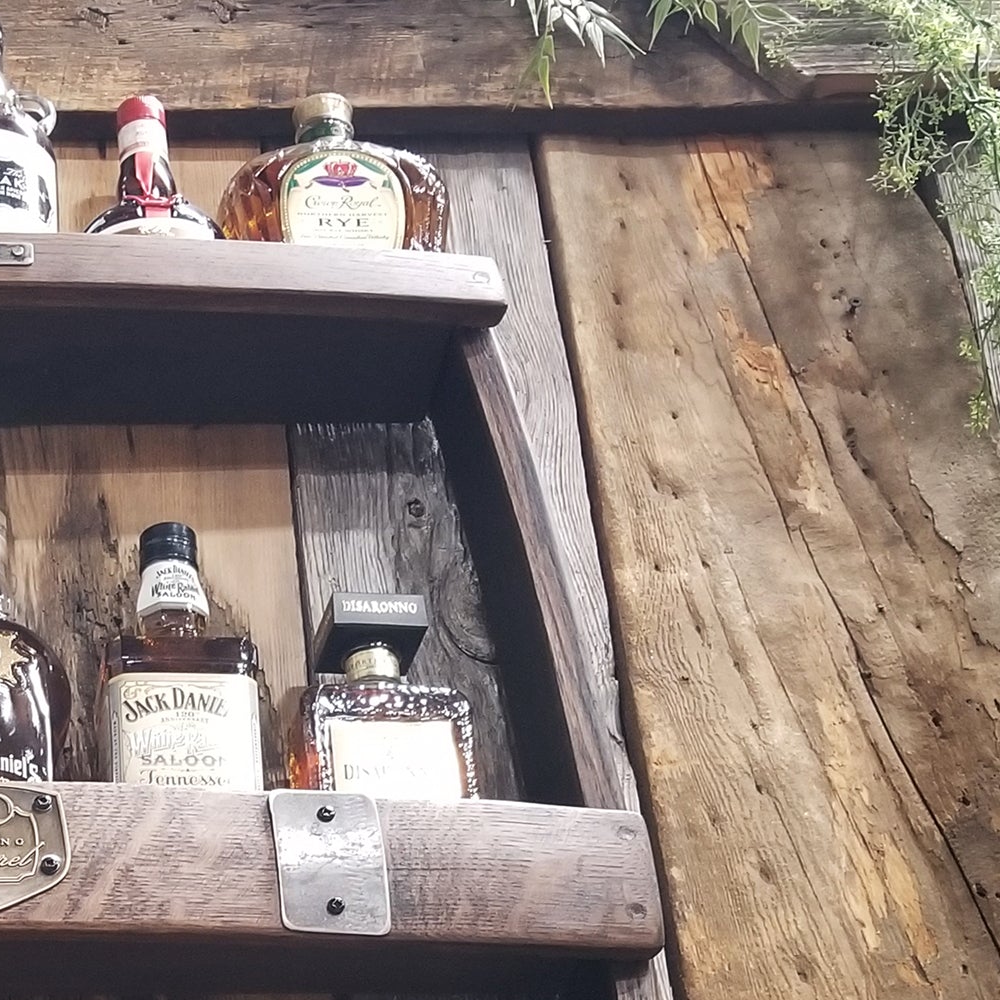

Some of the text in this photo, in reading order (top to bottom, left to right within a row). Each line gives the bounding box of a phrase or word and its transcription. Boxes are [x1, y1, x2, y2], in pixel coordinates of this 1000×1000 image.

[338, 195, 379, 210] Royal
[318, 217, 370, 228] RYE
[157, 591, 196, 600] SALOON
[342, 600, 418, 614] DISARONNO
[123, 687, 229, 722] JACK DANIE
